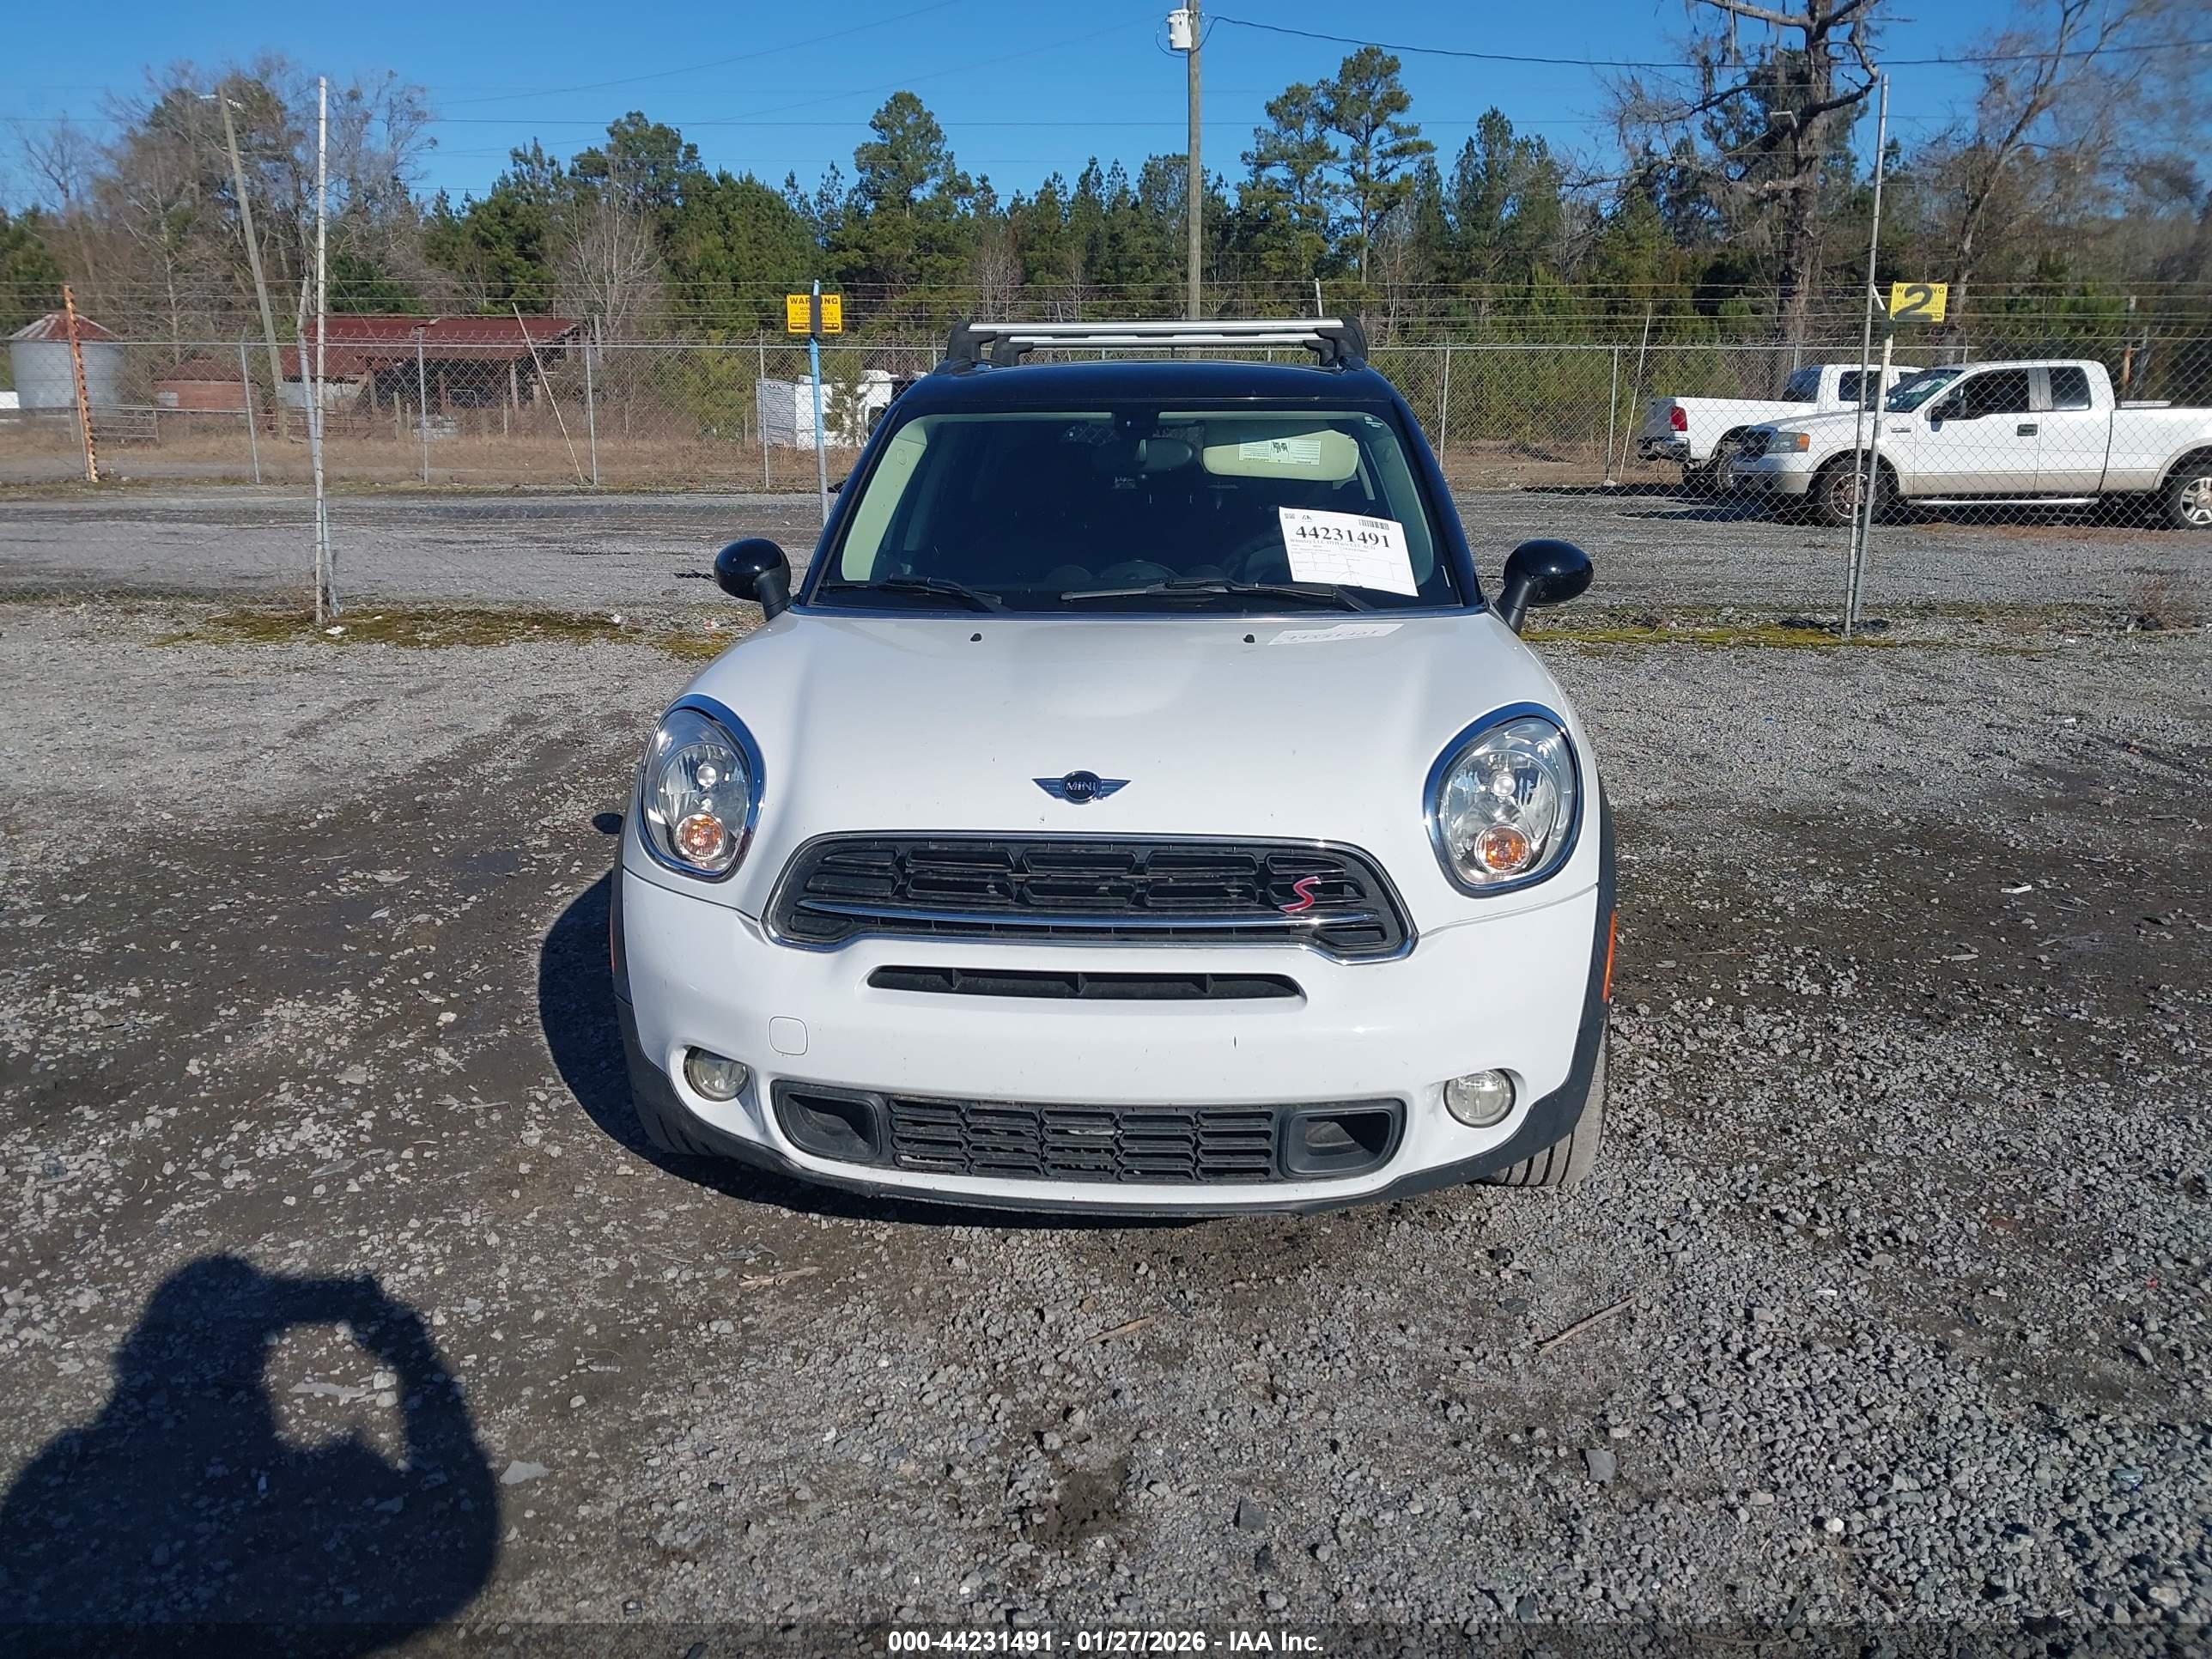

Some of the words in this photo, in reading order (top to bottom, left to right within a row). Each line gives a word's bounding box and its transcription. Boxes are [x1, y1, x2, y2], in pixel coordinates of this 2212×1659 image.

[1894, 284, 1933, 321] 2
[1296, 526, 1389, 548] 44231491
[1066, 781, 1097, 790] MINI
[1279, 876, 1322, 914] S
